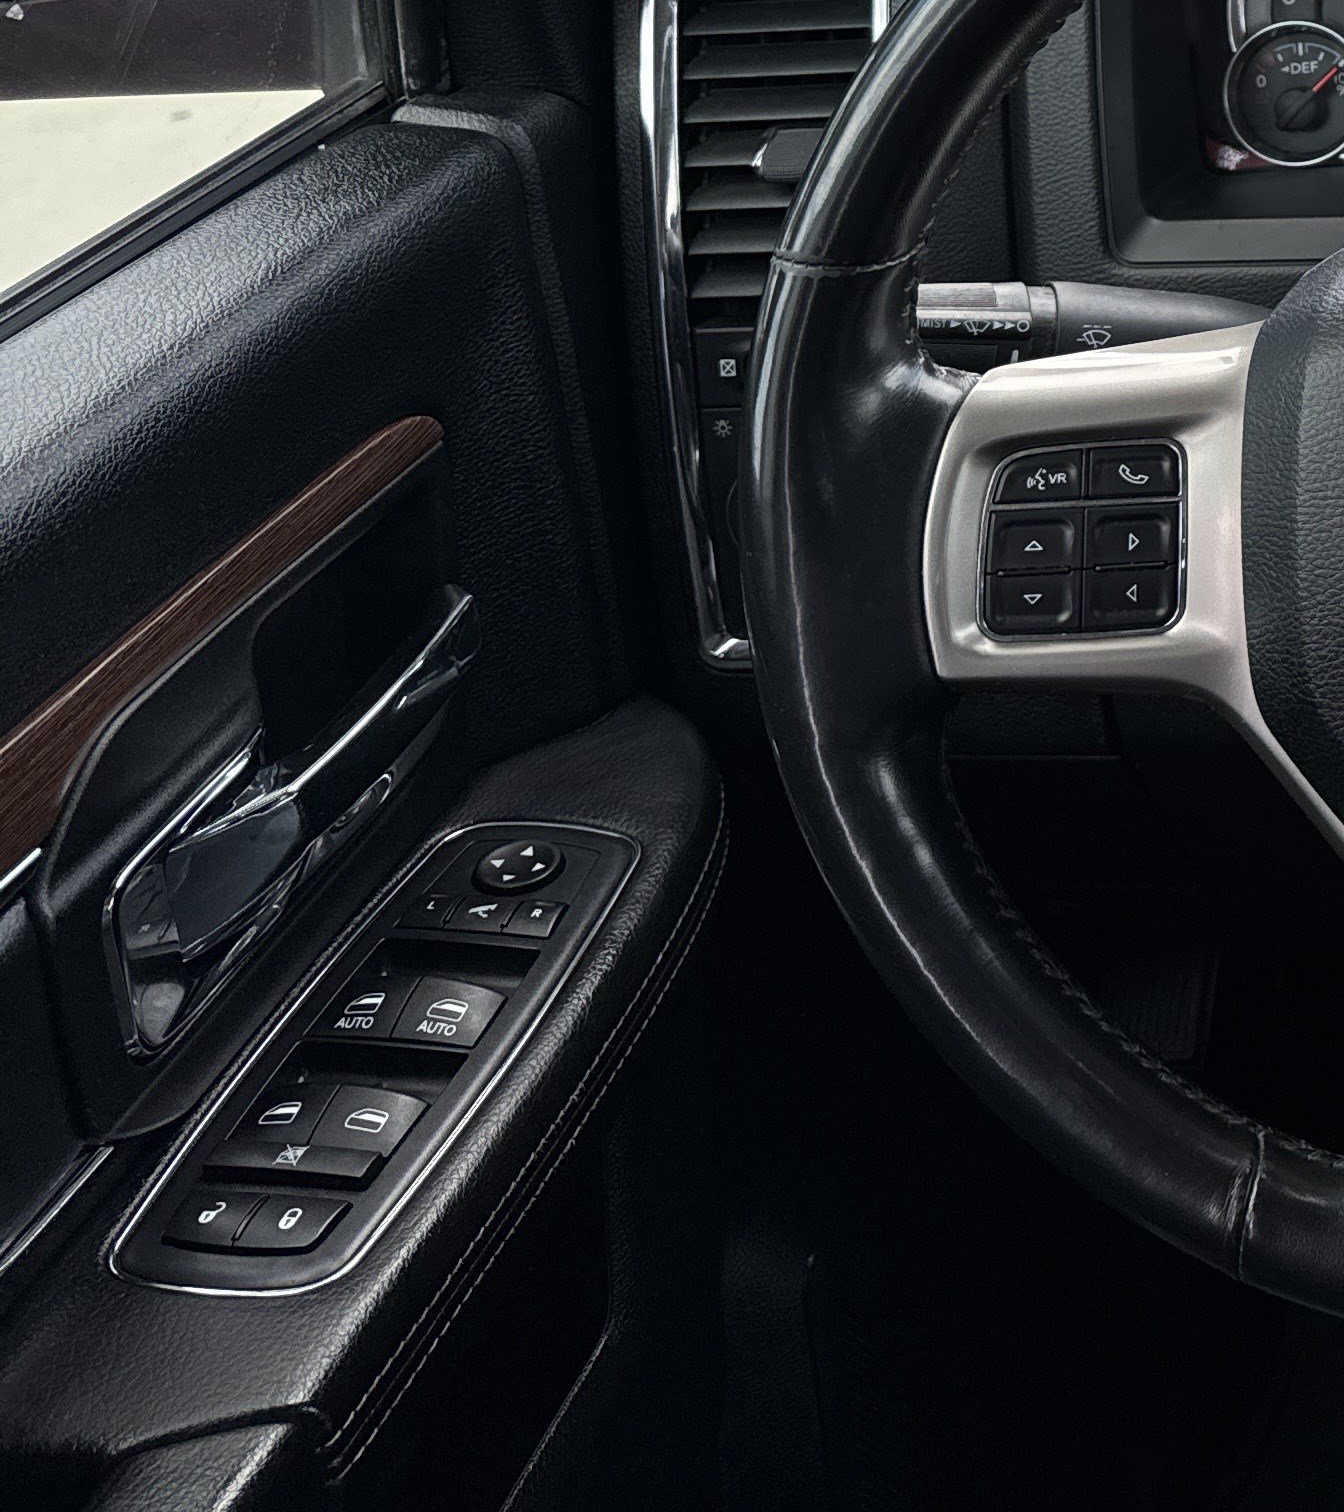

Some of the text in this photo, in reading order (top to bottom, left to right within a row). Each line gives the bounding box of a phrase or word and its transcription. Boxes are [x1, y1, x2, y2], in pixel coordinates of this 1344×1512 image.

[1290, 59, 1319, 75] DEF
[1255, 73, 1267, 89] 0
[1047, 471, 1068, 484] VR
[426, 900, 436, 911] L
[530, 908, 544, 919] R
[334, 1016, 374, 1030] AUTO
[416, 1020, 457, 1037] AUTO
